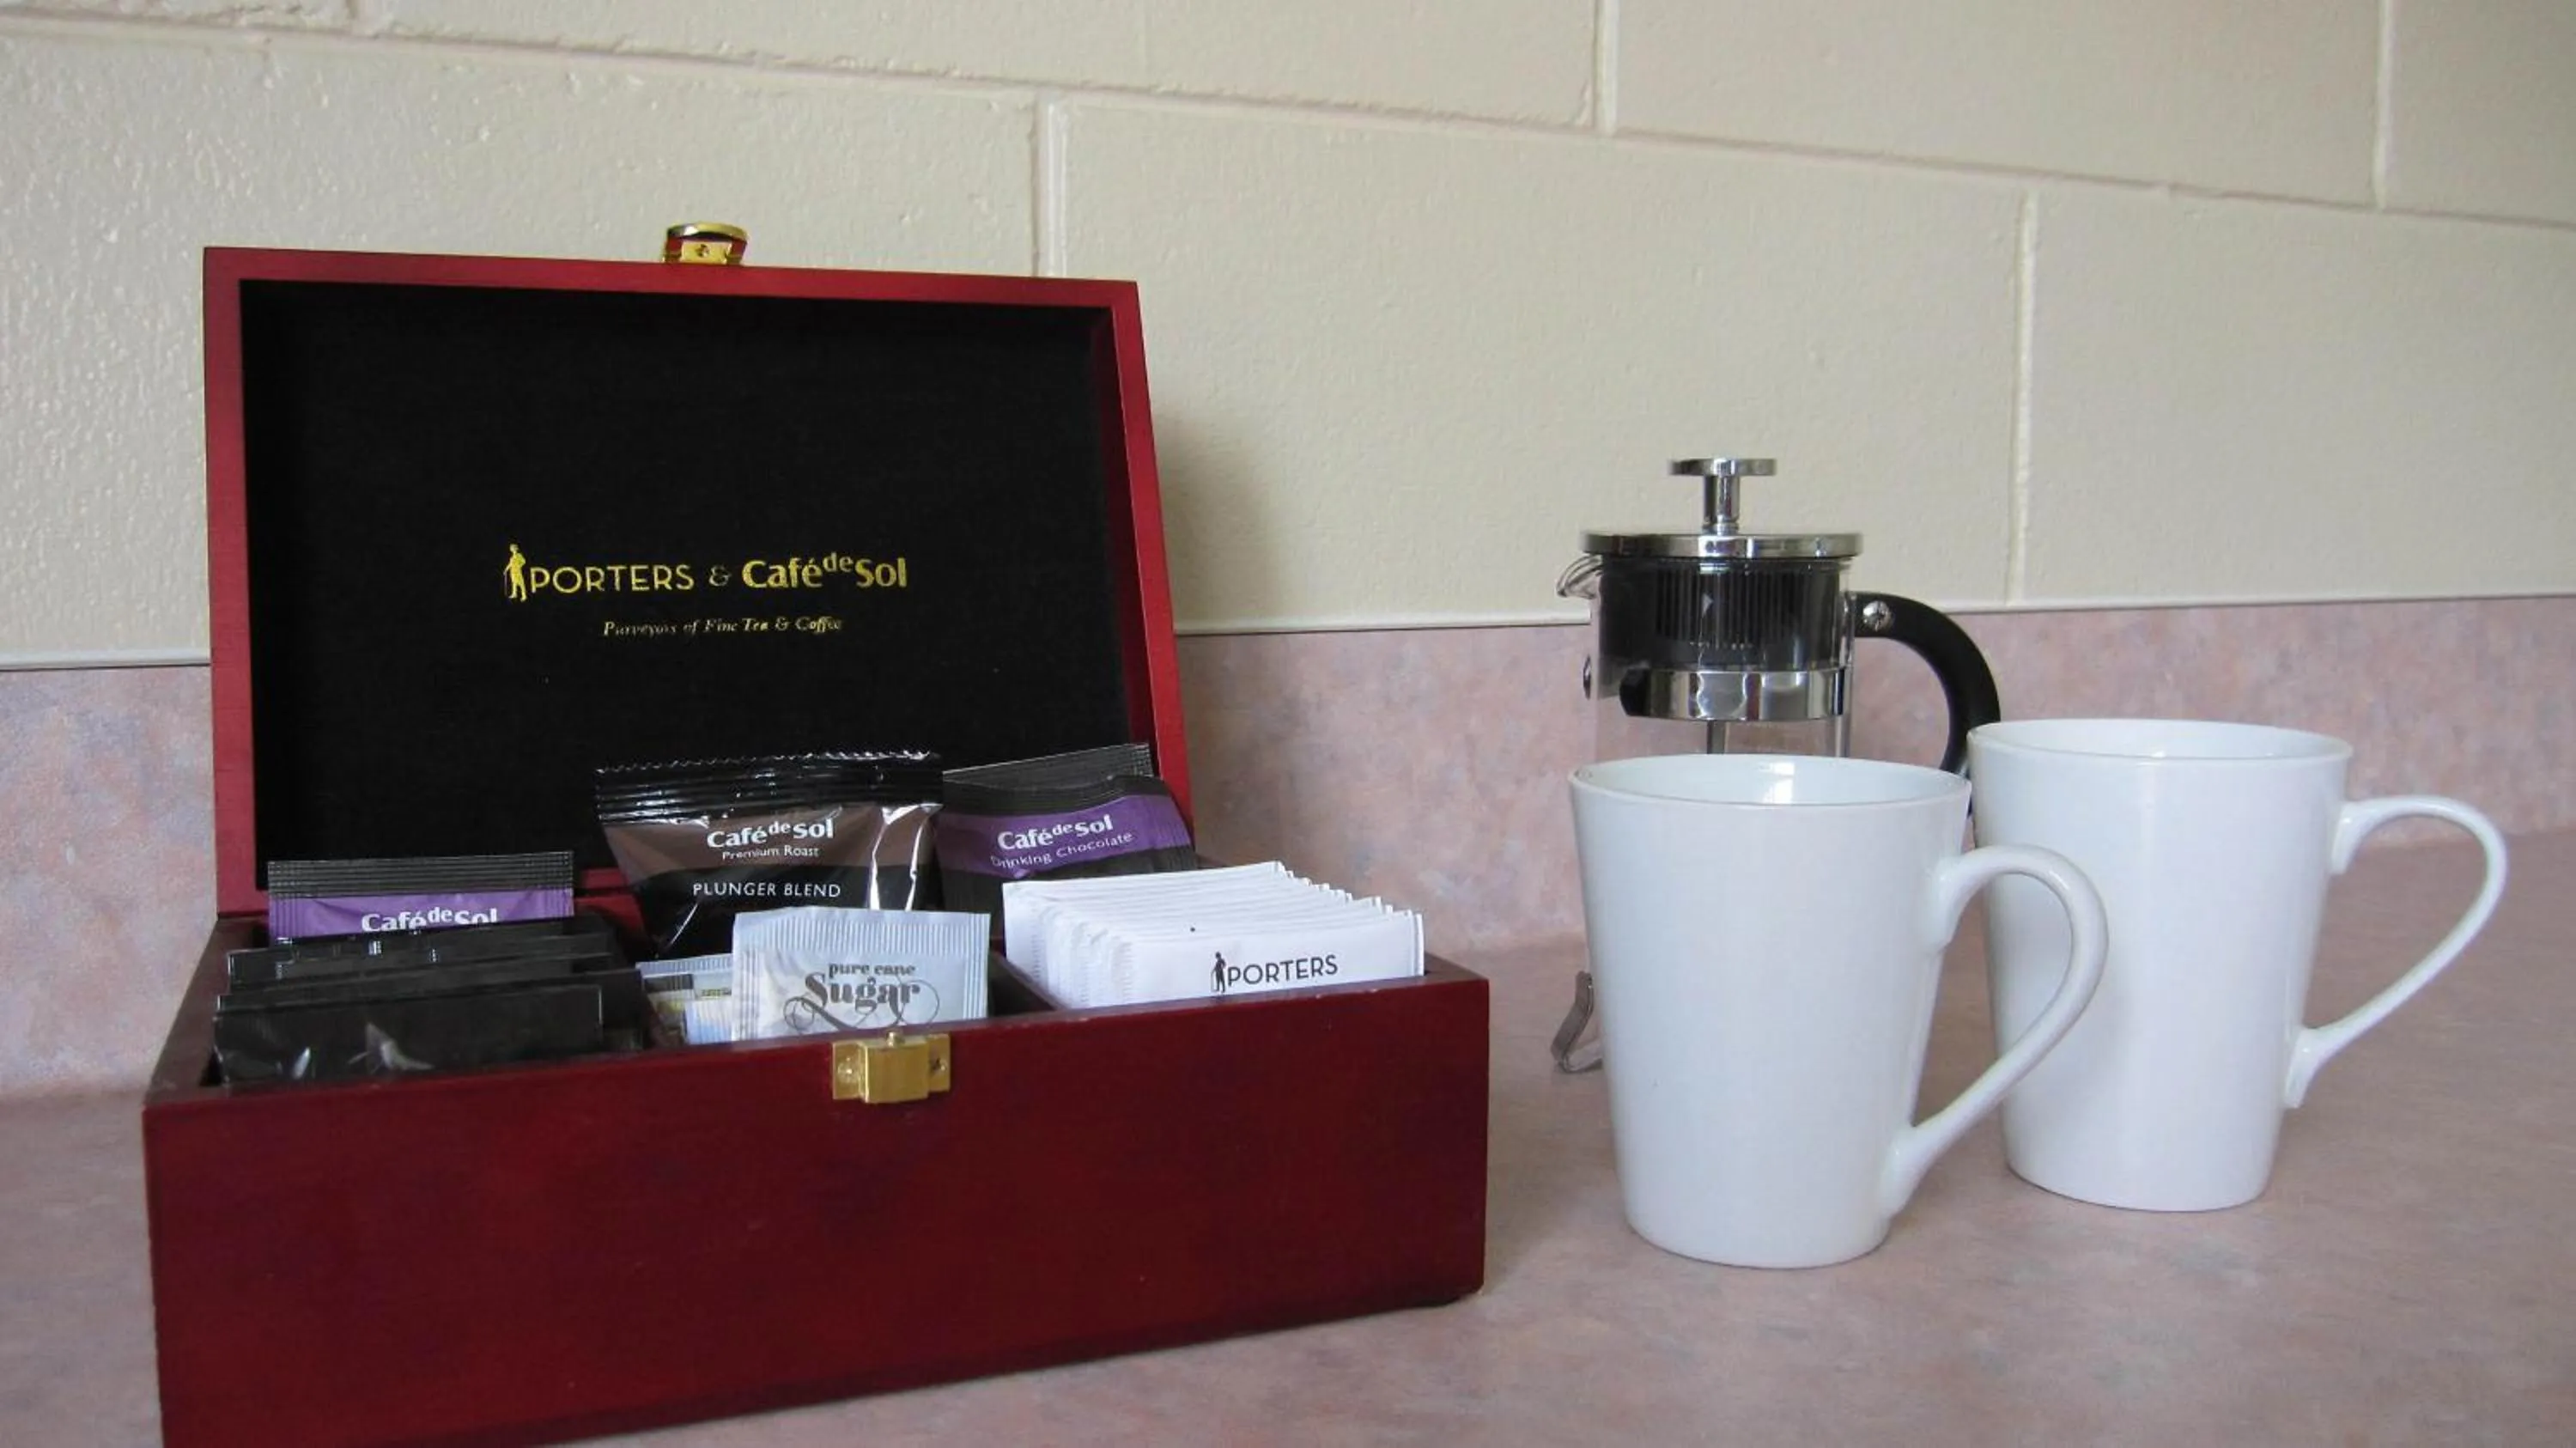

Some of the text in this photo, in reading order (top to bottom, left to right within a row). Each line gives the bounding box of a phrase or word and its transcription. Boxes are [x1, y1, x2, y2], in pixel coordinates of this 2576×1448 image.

[531, 564, 695, 593] PORTERS
[709, 566, 730, 587] &
[742, 558, 823, 588] Café
[855, 557, 908, 587] Sol
[775, 617, 789, 630] &
[707, 825, 769, 848] Café
[998, 828, 1054, 850] Café
[722, 844, 820, 860] Premium Roast
[990, 832, 1134, 869] Drinking Chocolate
[693, 882, 841, 897] PLUNGER BLEND
[828, 963, 917, 978] pure cane
[1227, 954, 1339, 987] PORTERS
[792, 970, 927, 1029] Sugar
